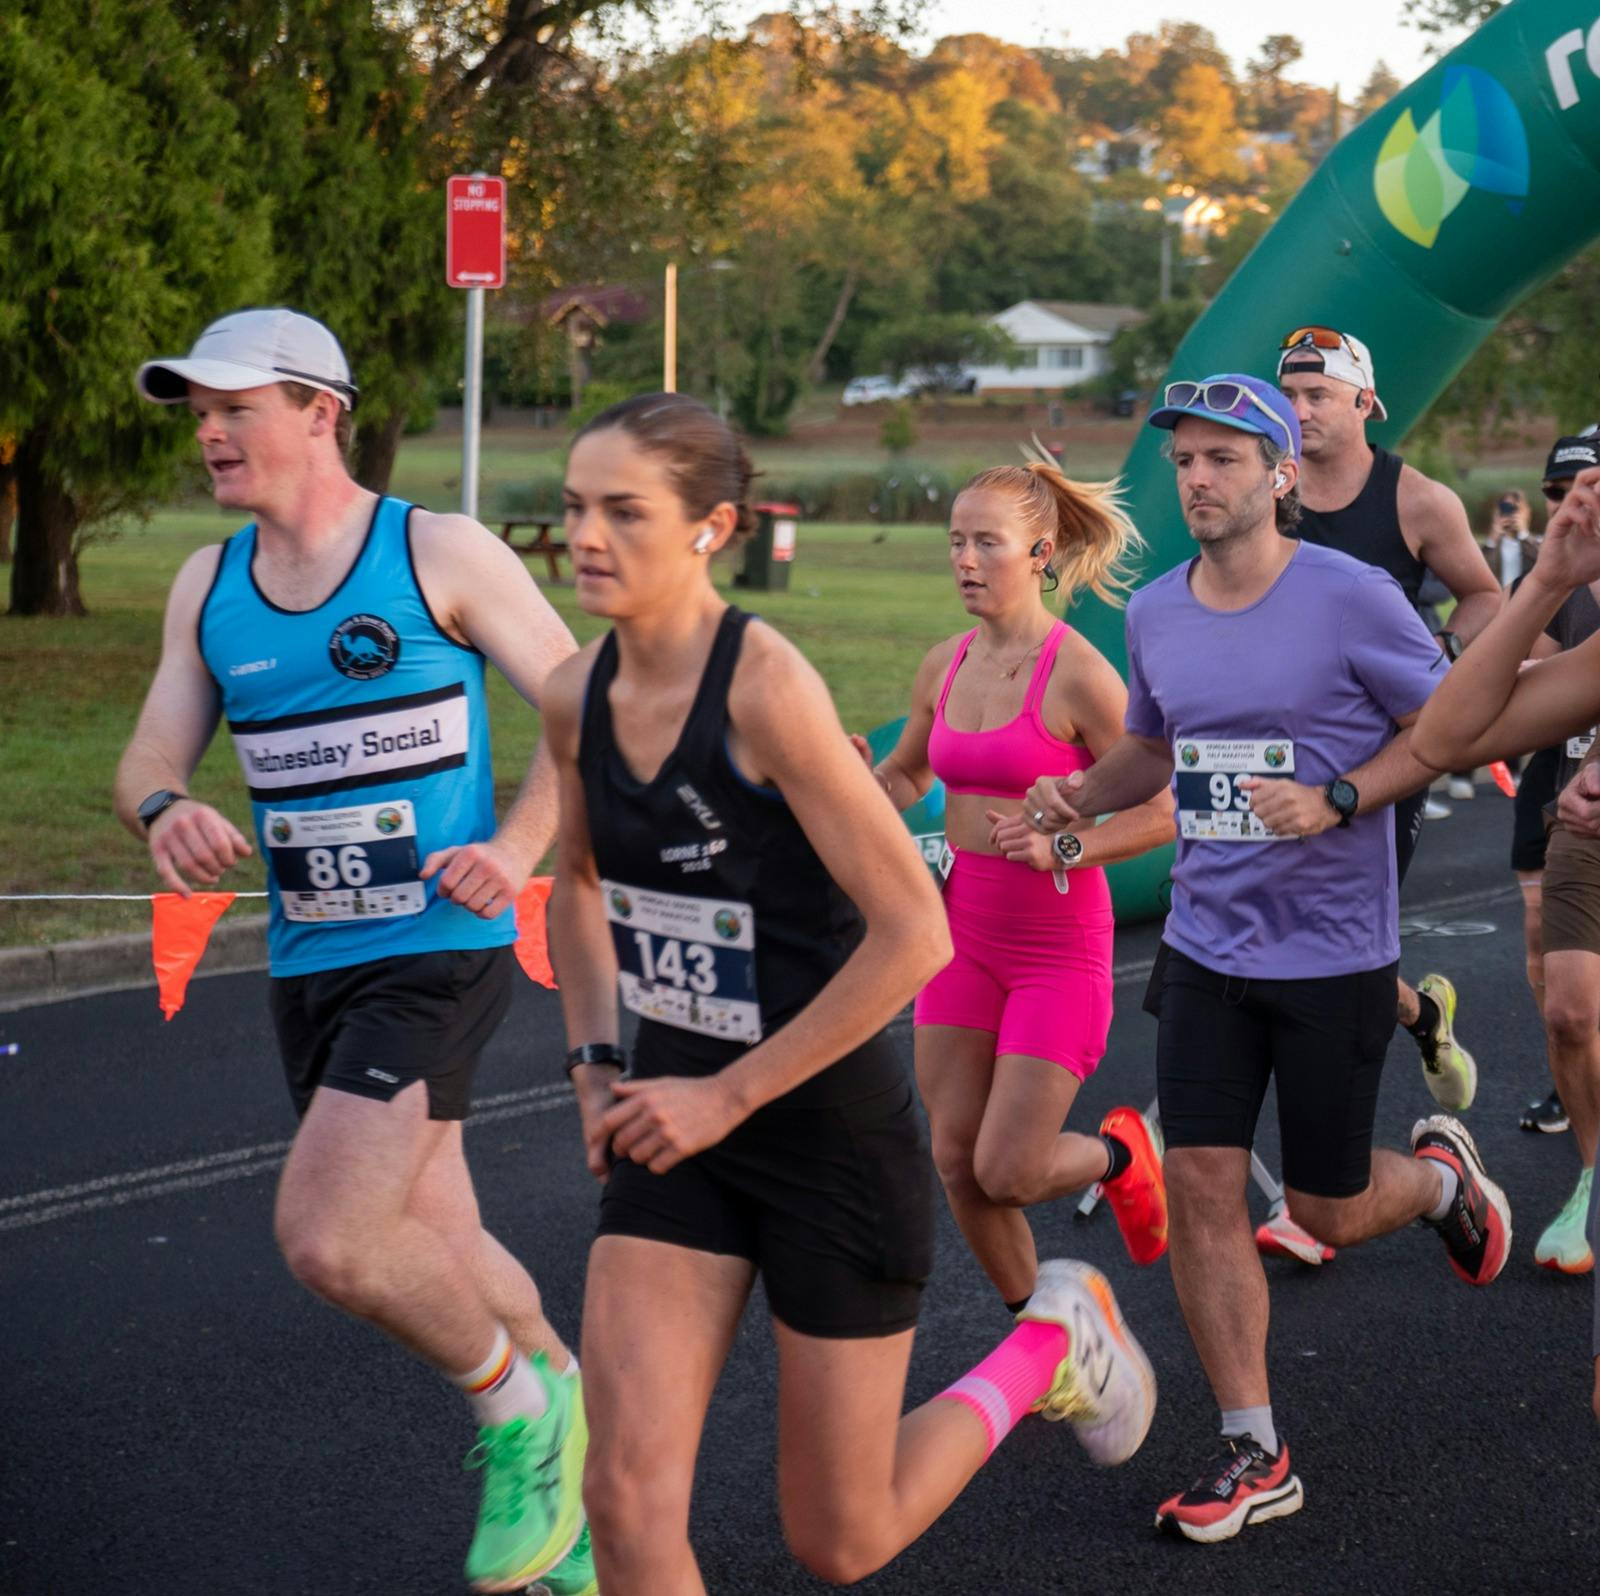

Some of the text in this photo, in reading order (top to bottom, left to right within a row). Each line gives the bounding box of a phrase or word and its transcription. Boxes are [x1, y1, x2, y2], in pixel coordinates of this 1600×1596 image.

[1545, 16, 1600, 111] r
[453, 197, 499, 213] STOPPING
[467, 183, 485, 198] NO
[361, 719, 442, 758] Social
[305, 845, 372, 890] 86
[633, 930, 718, 995] 143
